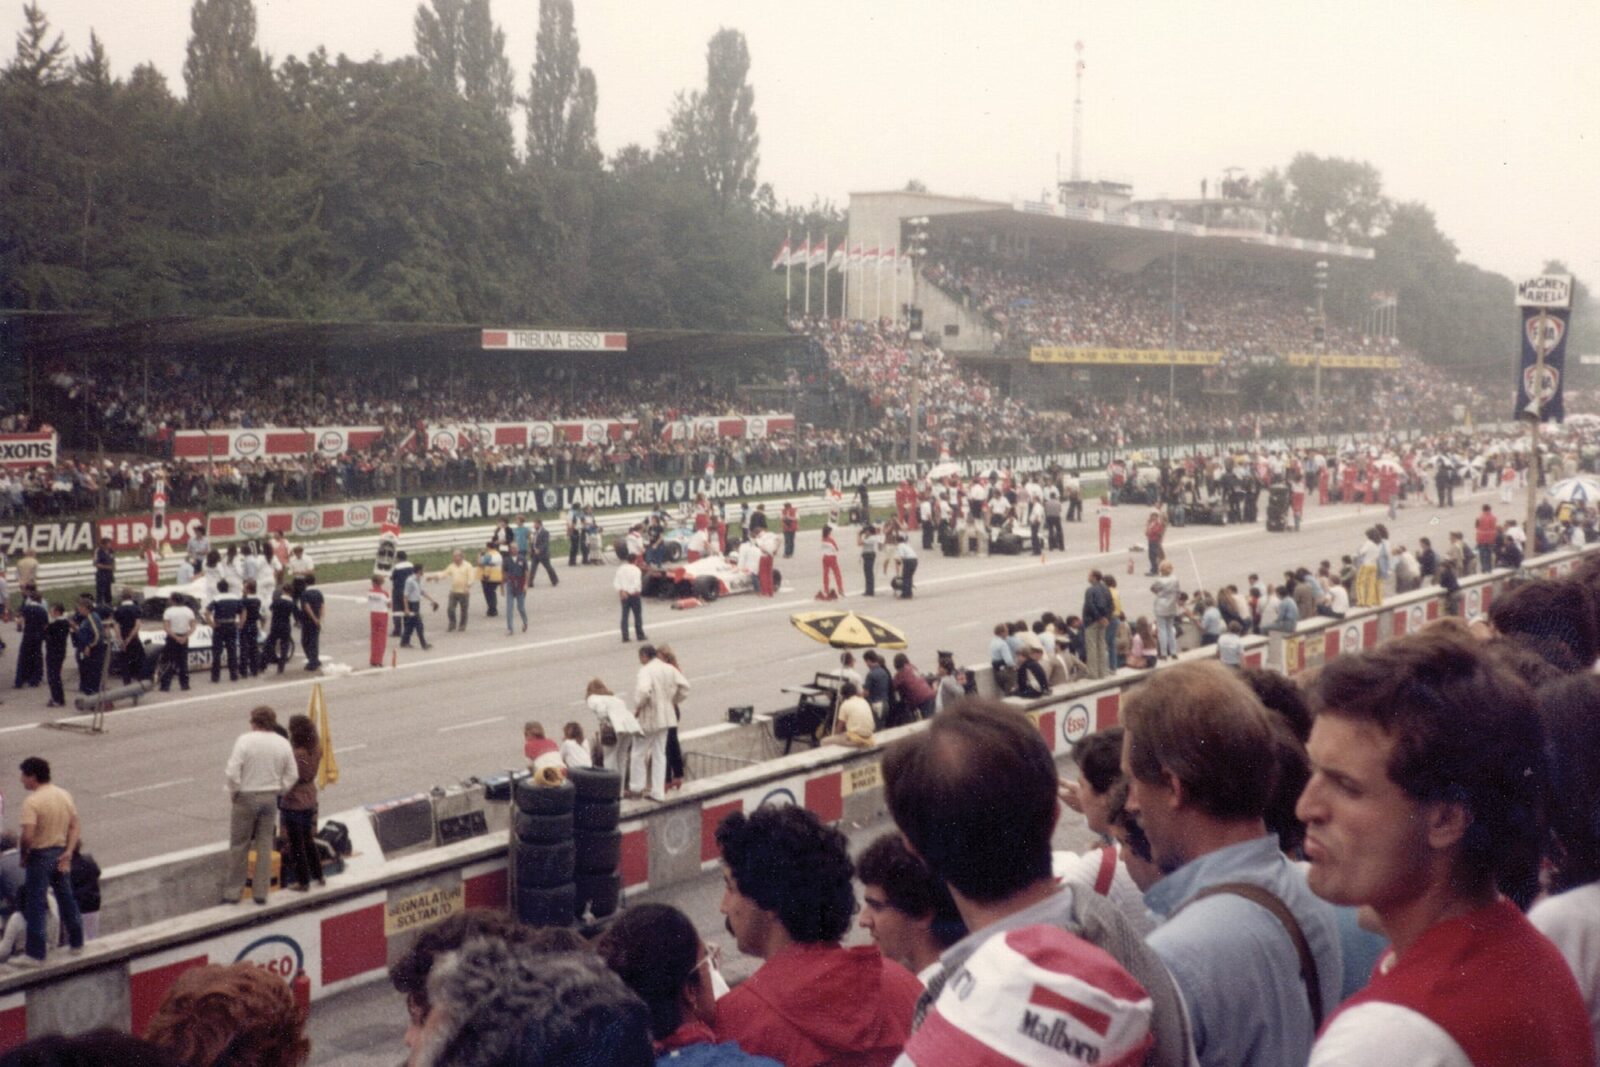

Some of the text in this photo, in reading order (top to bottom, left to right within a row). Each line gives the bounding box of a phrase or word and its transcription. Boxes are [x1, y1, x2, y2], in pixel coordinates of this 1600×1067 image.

[512, 332, 600, 348] TRIBUNA ESSO
[0, 442, 52, 459] xons
[412, 494, 482, 523] LANCIA
[487, 491, 538, 517] DELTA
[563, 484, 621, 509] LANCIA
[626, 481, 669, 505] TREVI
[743, 473, 793, 495] GAMMA
[797, 470, 827, 490] A112
[843, 466, 884, 487] LANCIA
[0, 522, 93, 555] FAEMA
[1067, 716, 1086, 734] Esso
